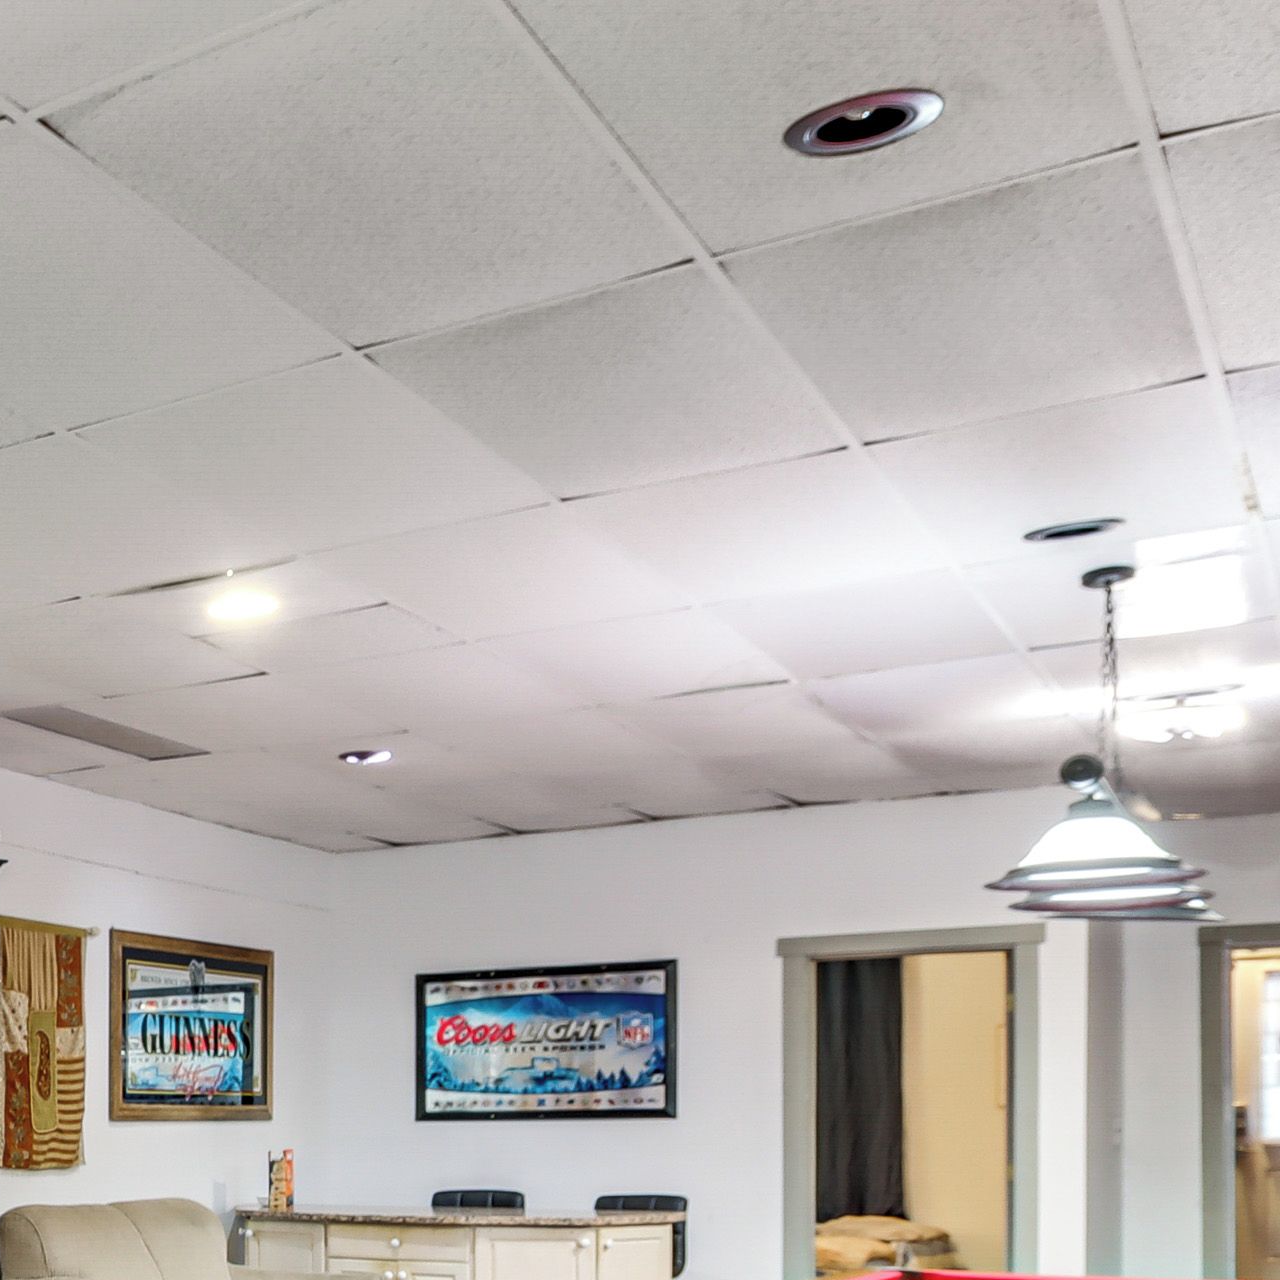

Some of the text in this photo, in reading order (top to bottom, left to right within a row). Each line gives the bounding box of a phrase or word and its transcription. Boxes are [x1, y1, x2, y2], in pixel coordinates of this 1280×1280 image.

[141, 1014, 251, 1060] GUINNESS
[437, 1015, 610, 1046] Coors LIGHT
